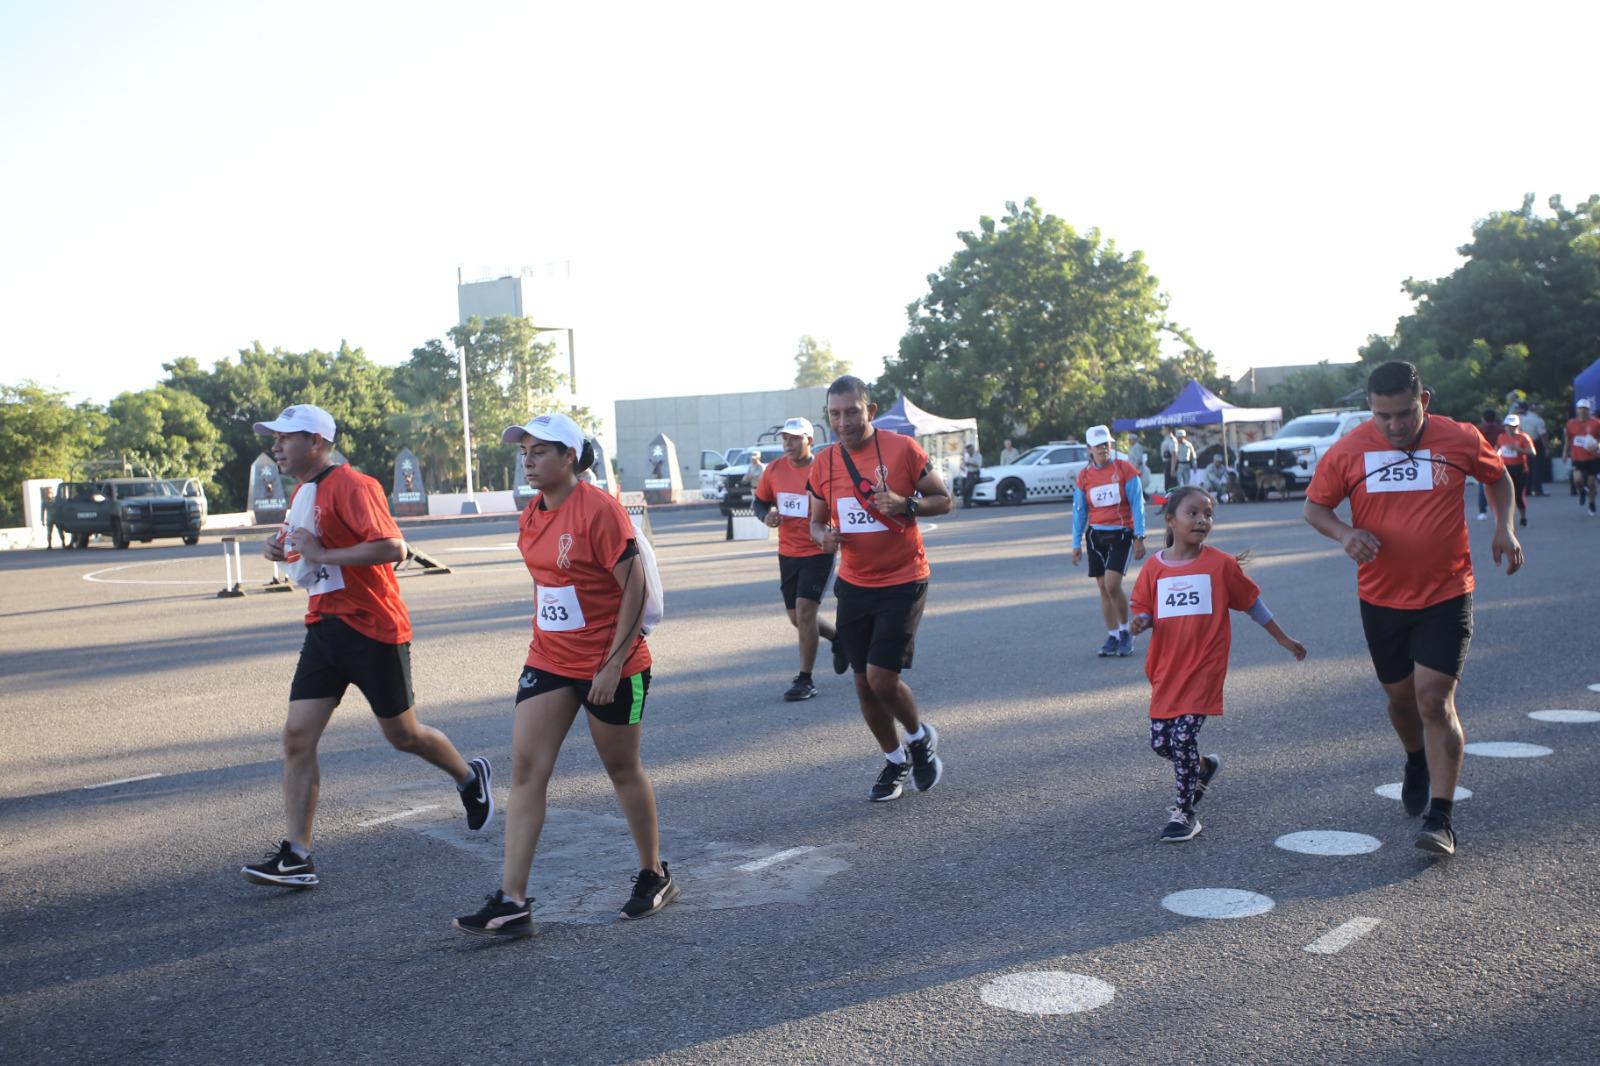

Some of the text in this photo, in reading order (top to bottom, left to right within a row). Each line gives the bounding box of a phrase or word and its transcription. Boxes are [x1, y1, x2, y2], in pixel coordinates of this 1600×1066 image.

[1379, 467, 1418, 482] 259
[1096, 490, 1113, 501] 271
[783, 500, 801, 510] 461
[1165, 591, 1200, 607] 425
[541, 605, 569, 621] 433
